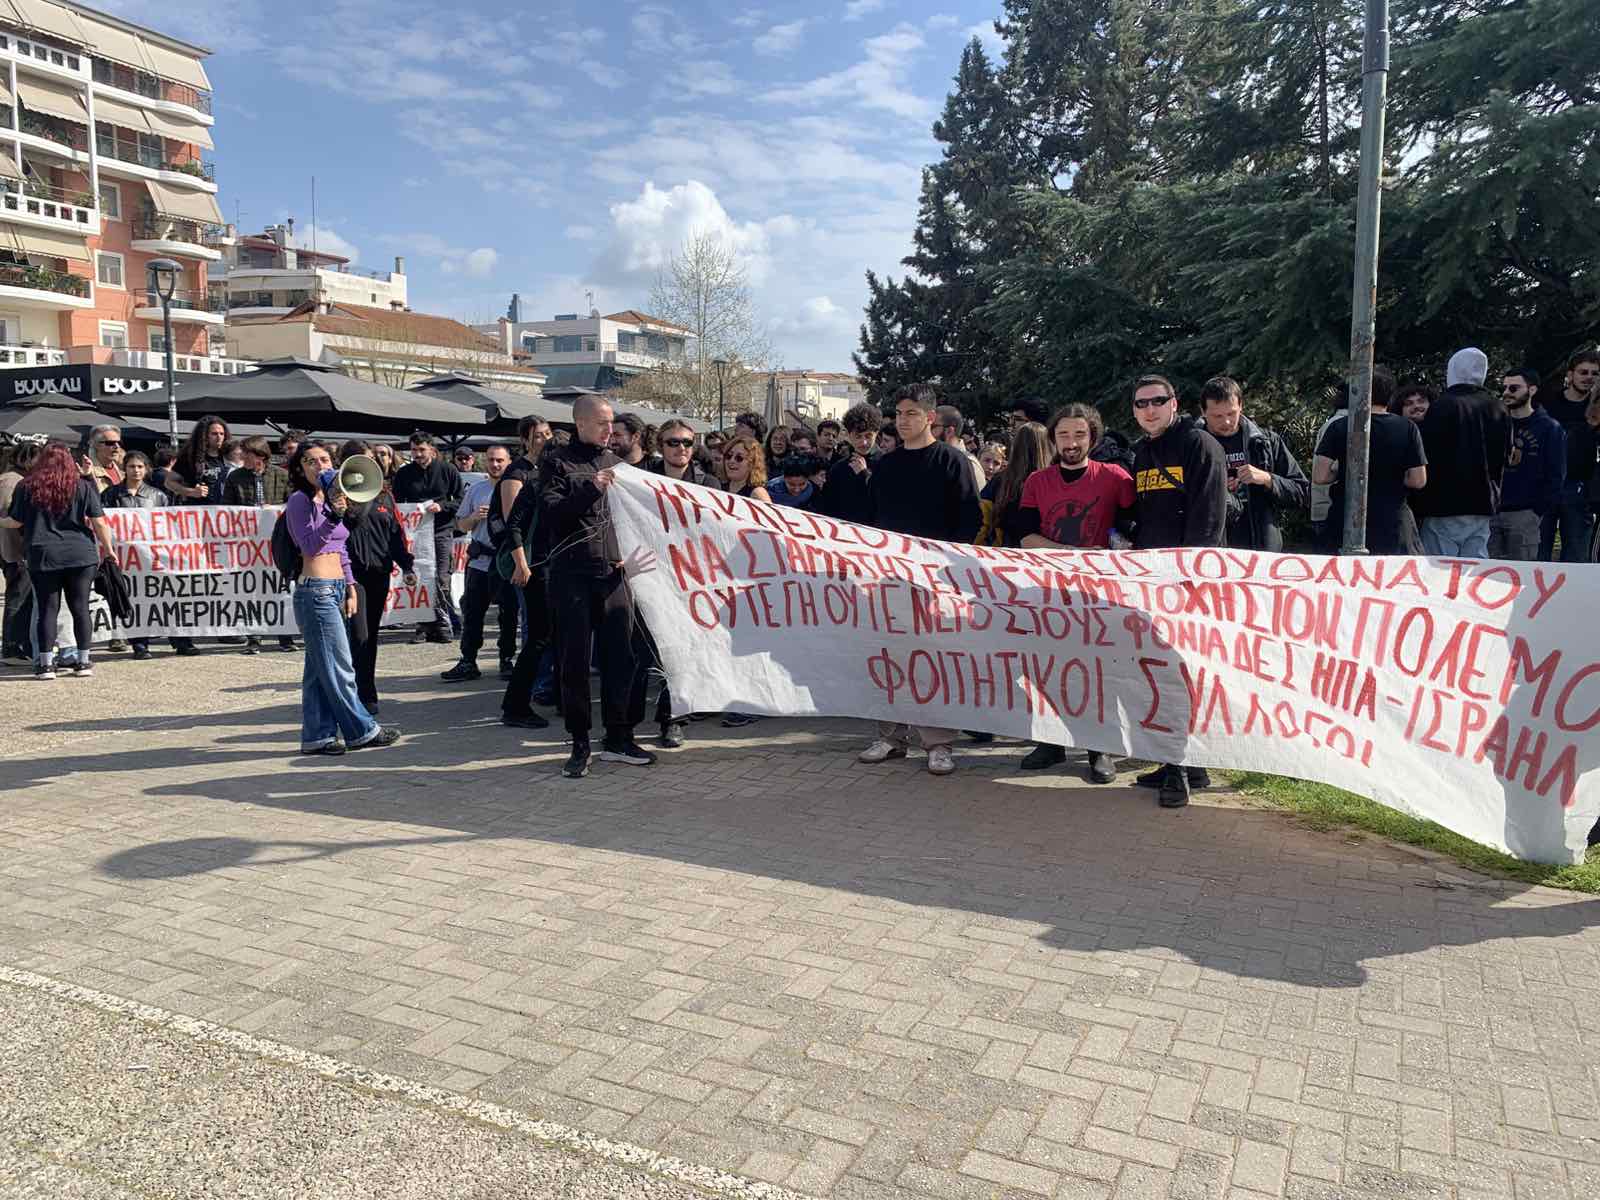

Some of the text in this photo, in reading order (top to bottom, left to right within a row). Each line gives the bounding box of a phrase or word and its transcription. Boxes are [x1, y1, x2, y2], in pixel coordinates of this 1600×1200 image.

[150, 510, 258, 541] ΕΜΠΛΟΚΗ
[642, 480, 721, 533] ΝΑ
[1158, 548, 1259, 579] ΤΟΥ
[147, 600, 284, 628] ΑΜΕΡΙΚΑΝΟΙ
[669, 534, 734, 591] ΝΑ
[1352, 597, 1600, 732] ΠΟΛΕΜΟ
[689, 583, 780, 630] ΟΥΤΕ
[783, 580, 819, 627] ΓΗ
[824, 583, 907, 634] ΟΥΤΕ
[911, 586, 992, 636] ΝΕΡΟ
[993, 602, 1115, 646] ΣΤΟΥΣ
[1124, 612, 1296, 692] ΦΟΝΙΑΔΕΣ
[868, 648, 1105, 723] ΦΟΙΤΗΤΙΚΟΙ
